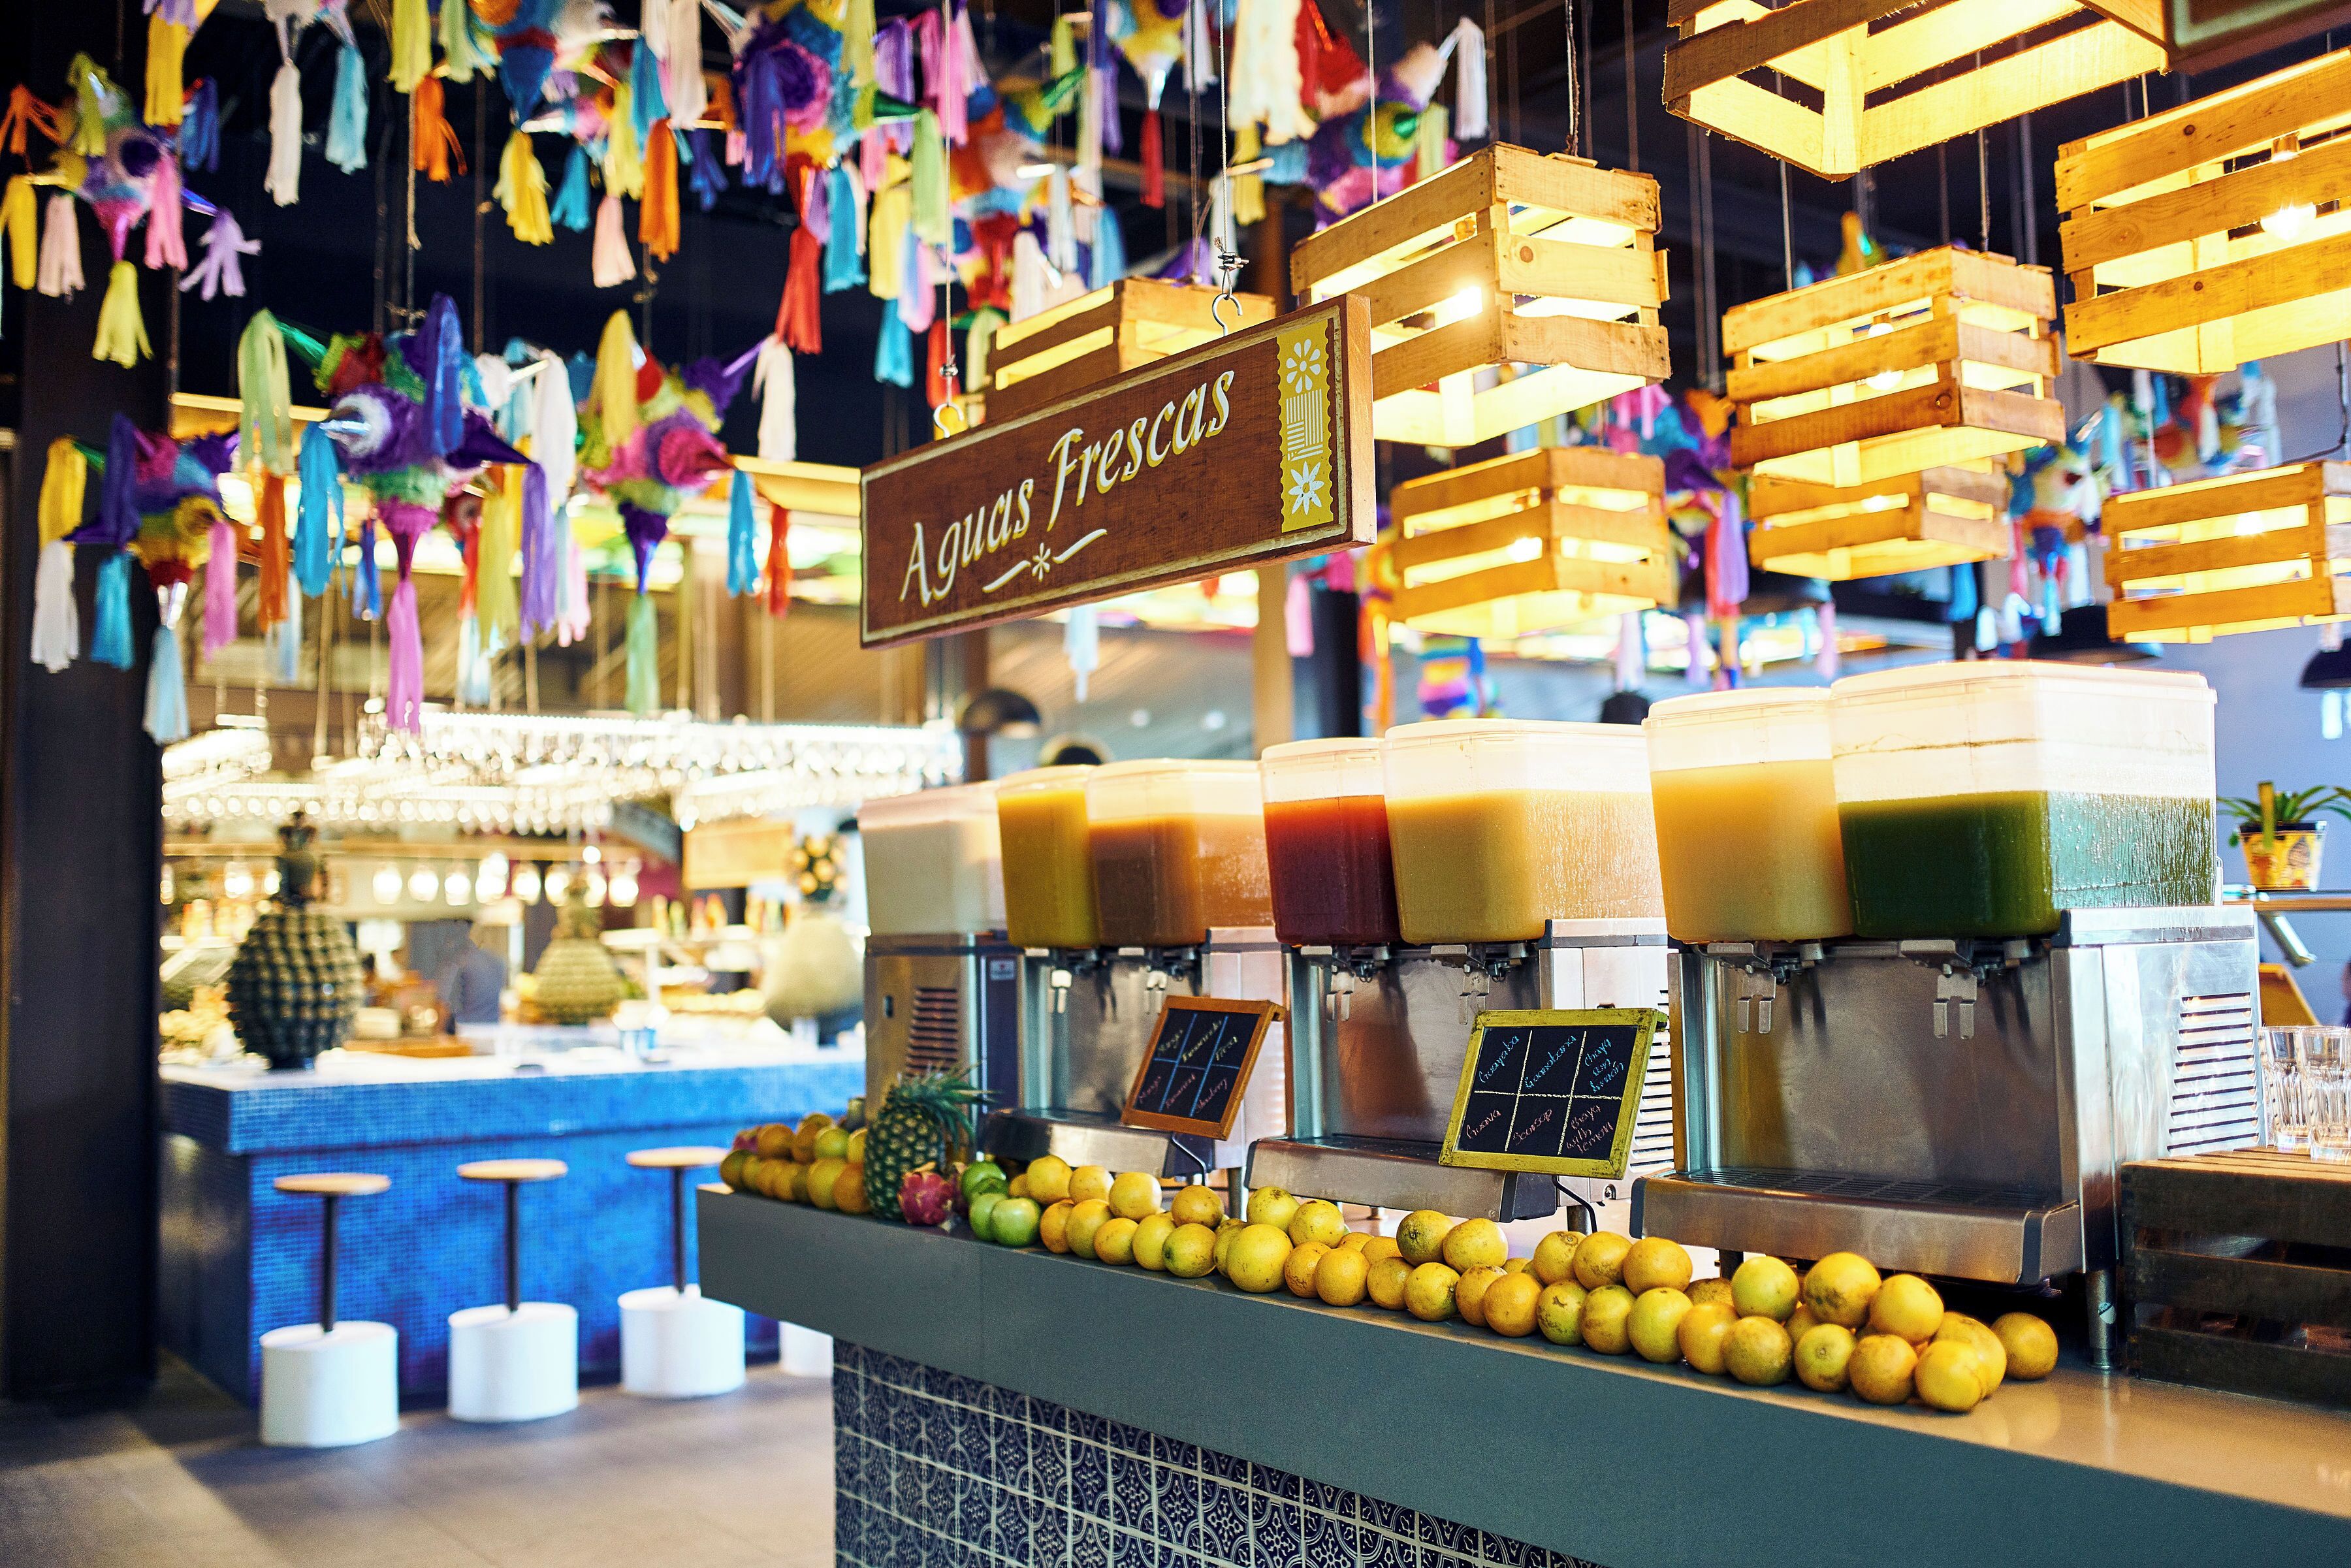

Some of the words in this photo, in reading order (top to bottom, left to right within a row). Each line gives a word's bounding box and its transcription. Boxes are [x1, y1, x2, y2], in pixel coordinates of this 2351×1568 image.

[899, 478, 1034, 608] Aguas
[1047, 370, 1234, 532] Frescas
[1479, 1035, 1520, 1083] Guayaba
[1466, 1110, 1501, 1139] Guava
